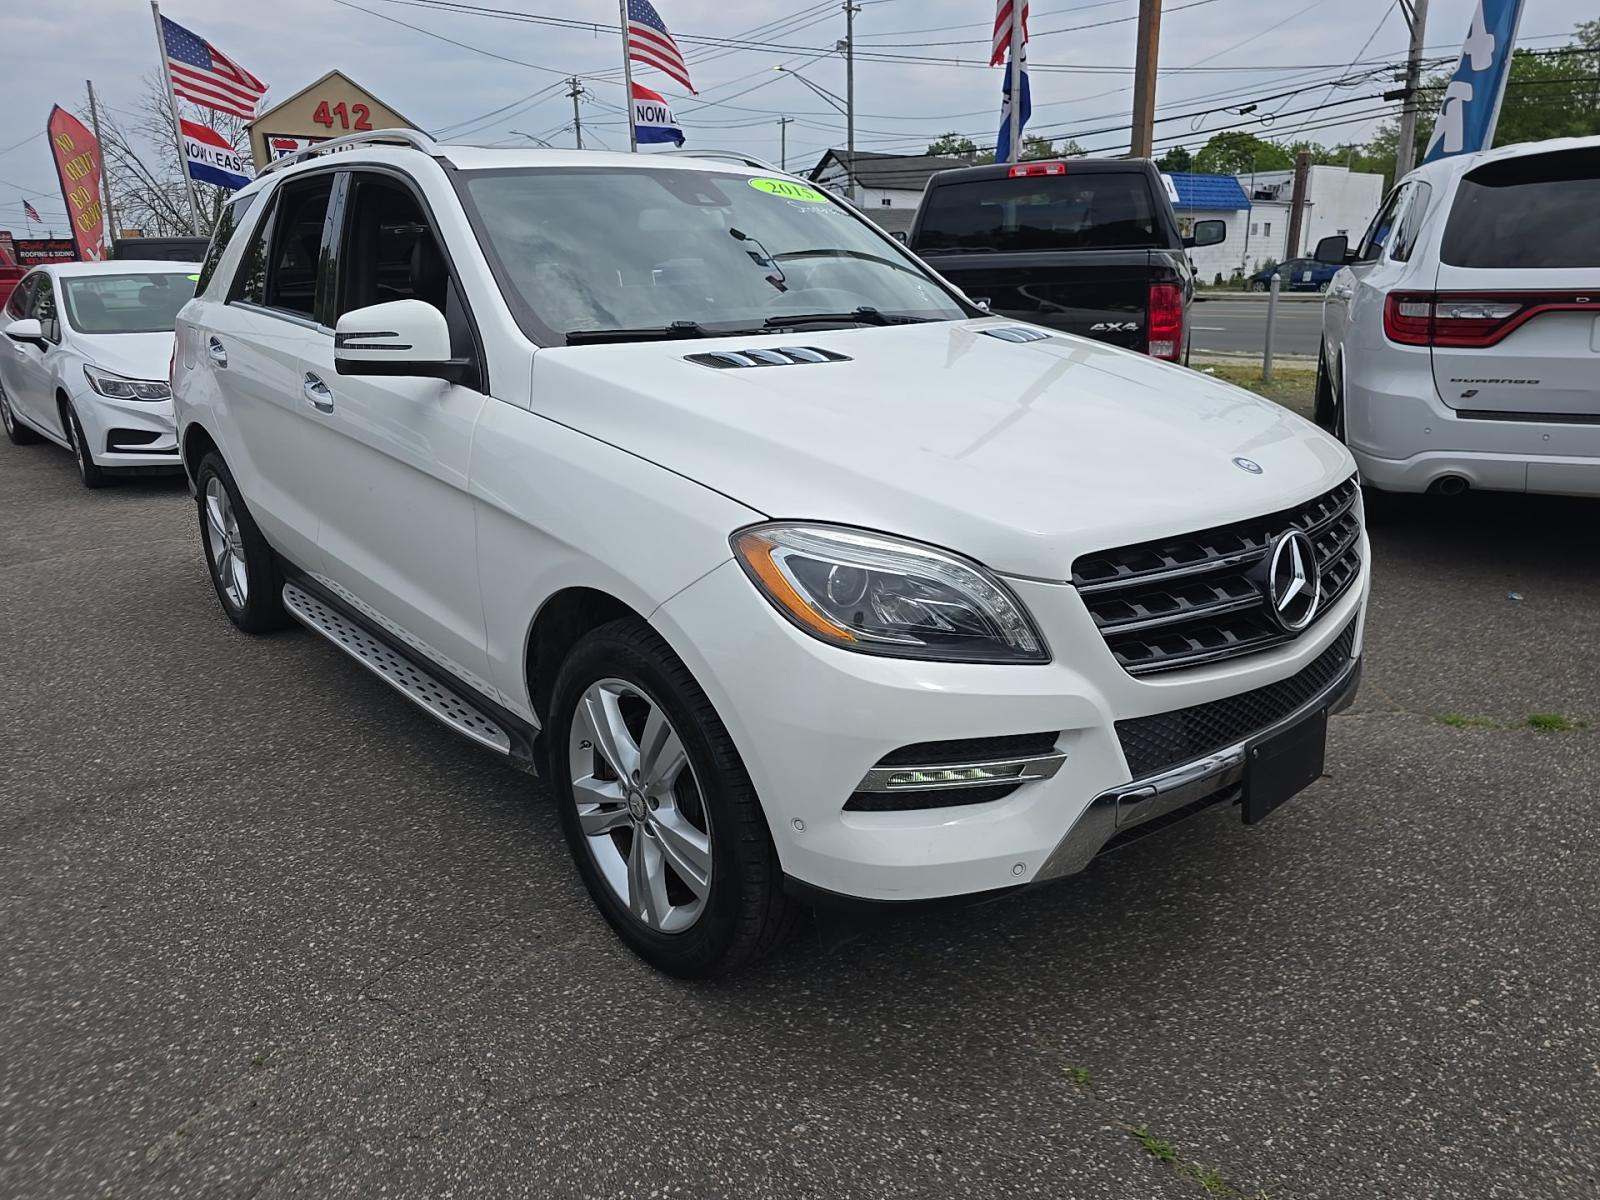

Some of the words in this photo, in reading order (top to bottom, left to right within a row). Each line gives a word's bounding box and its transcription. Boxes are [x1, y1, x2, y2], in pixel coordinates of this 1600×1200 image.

[313, 100, 373, 131] 412
[636, 105, 666, 123] NOW
[55, 133, 75, 155] NO
[64, 150, 97, 181] CREDIT
[765, 181, 814, 200] 2015
[20, 250, 48, 258] ROOFING
